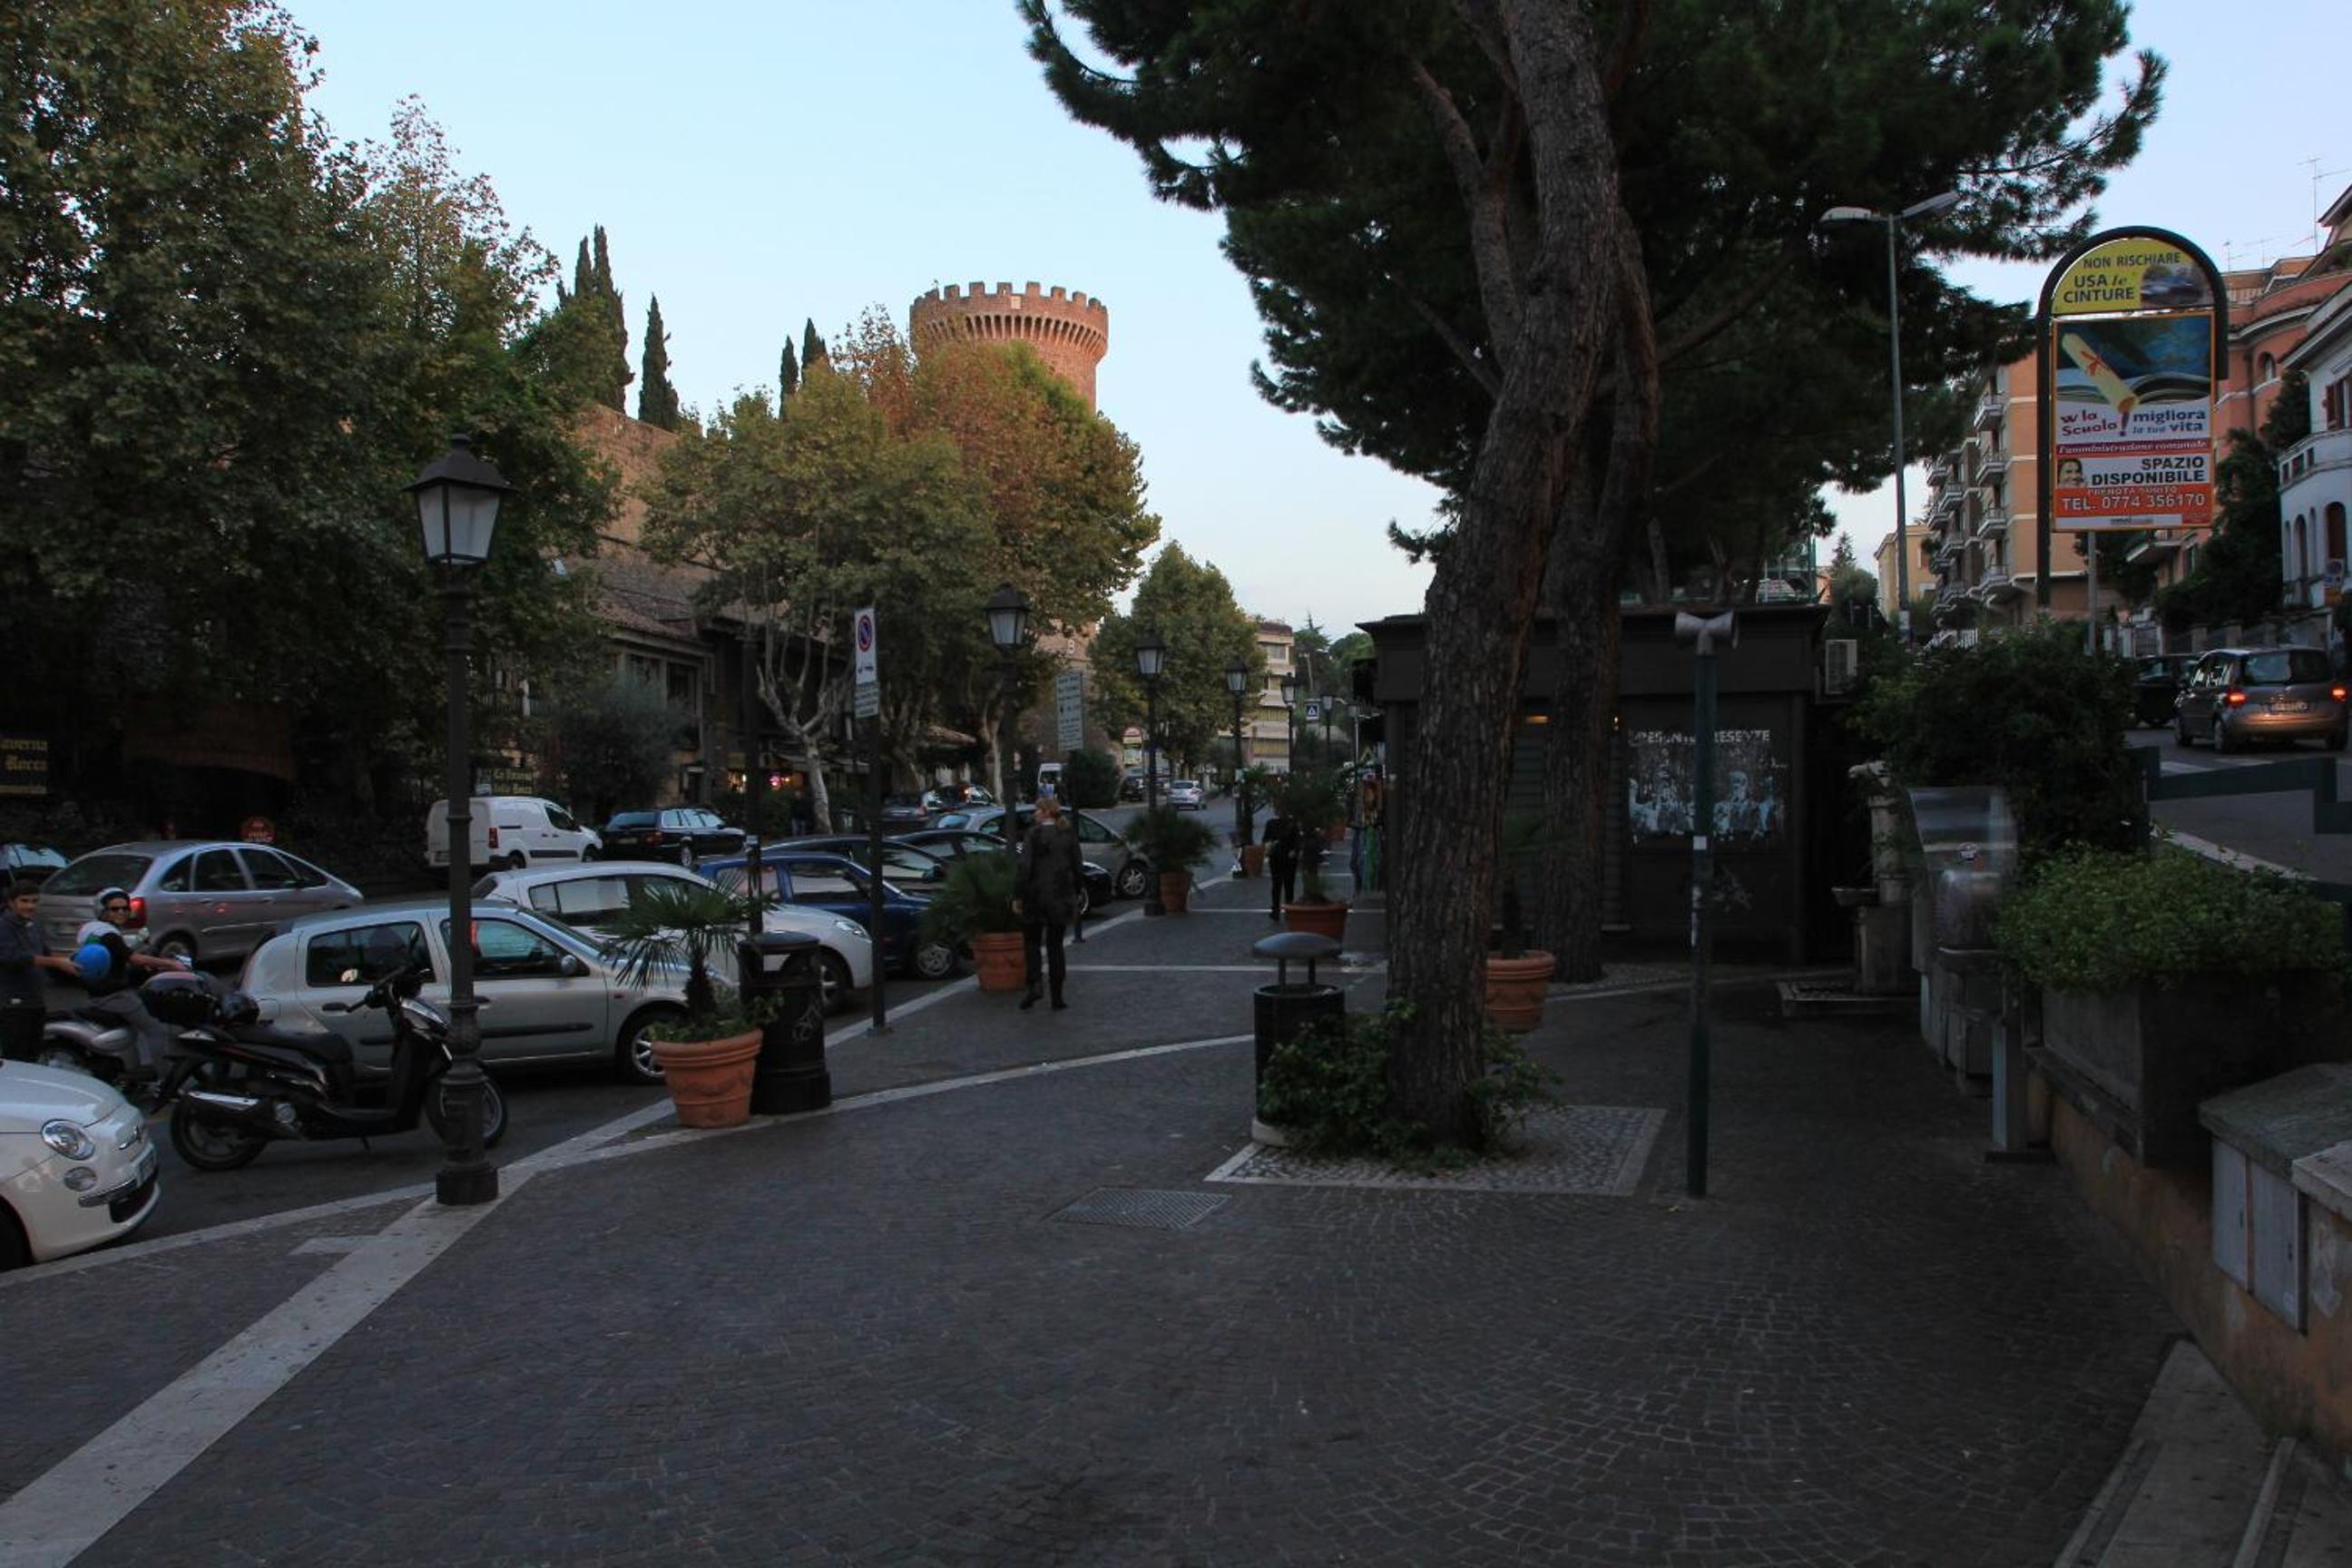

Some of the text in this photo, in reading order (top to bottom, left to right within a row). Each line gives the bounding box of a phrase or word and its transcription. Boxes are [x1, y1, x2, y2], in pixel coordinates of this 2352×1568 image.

[2082, 252, 2181, 270] NON RISCHIARE
[2073, 274, 2128, 289] USA le
[2063, 288, 2135, 304] CINTURE
[2133, 409, 2207, 424] migliora
[2169, 421, 2204, 433] vita
[2141, 456, 2205, 471] SPAZIO
[2092, 470, 2205, 485] DISPONIBILE
[2062, 493, 2206, 511] TEL. 0774 356170
